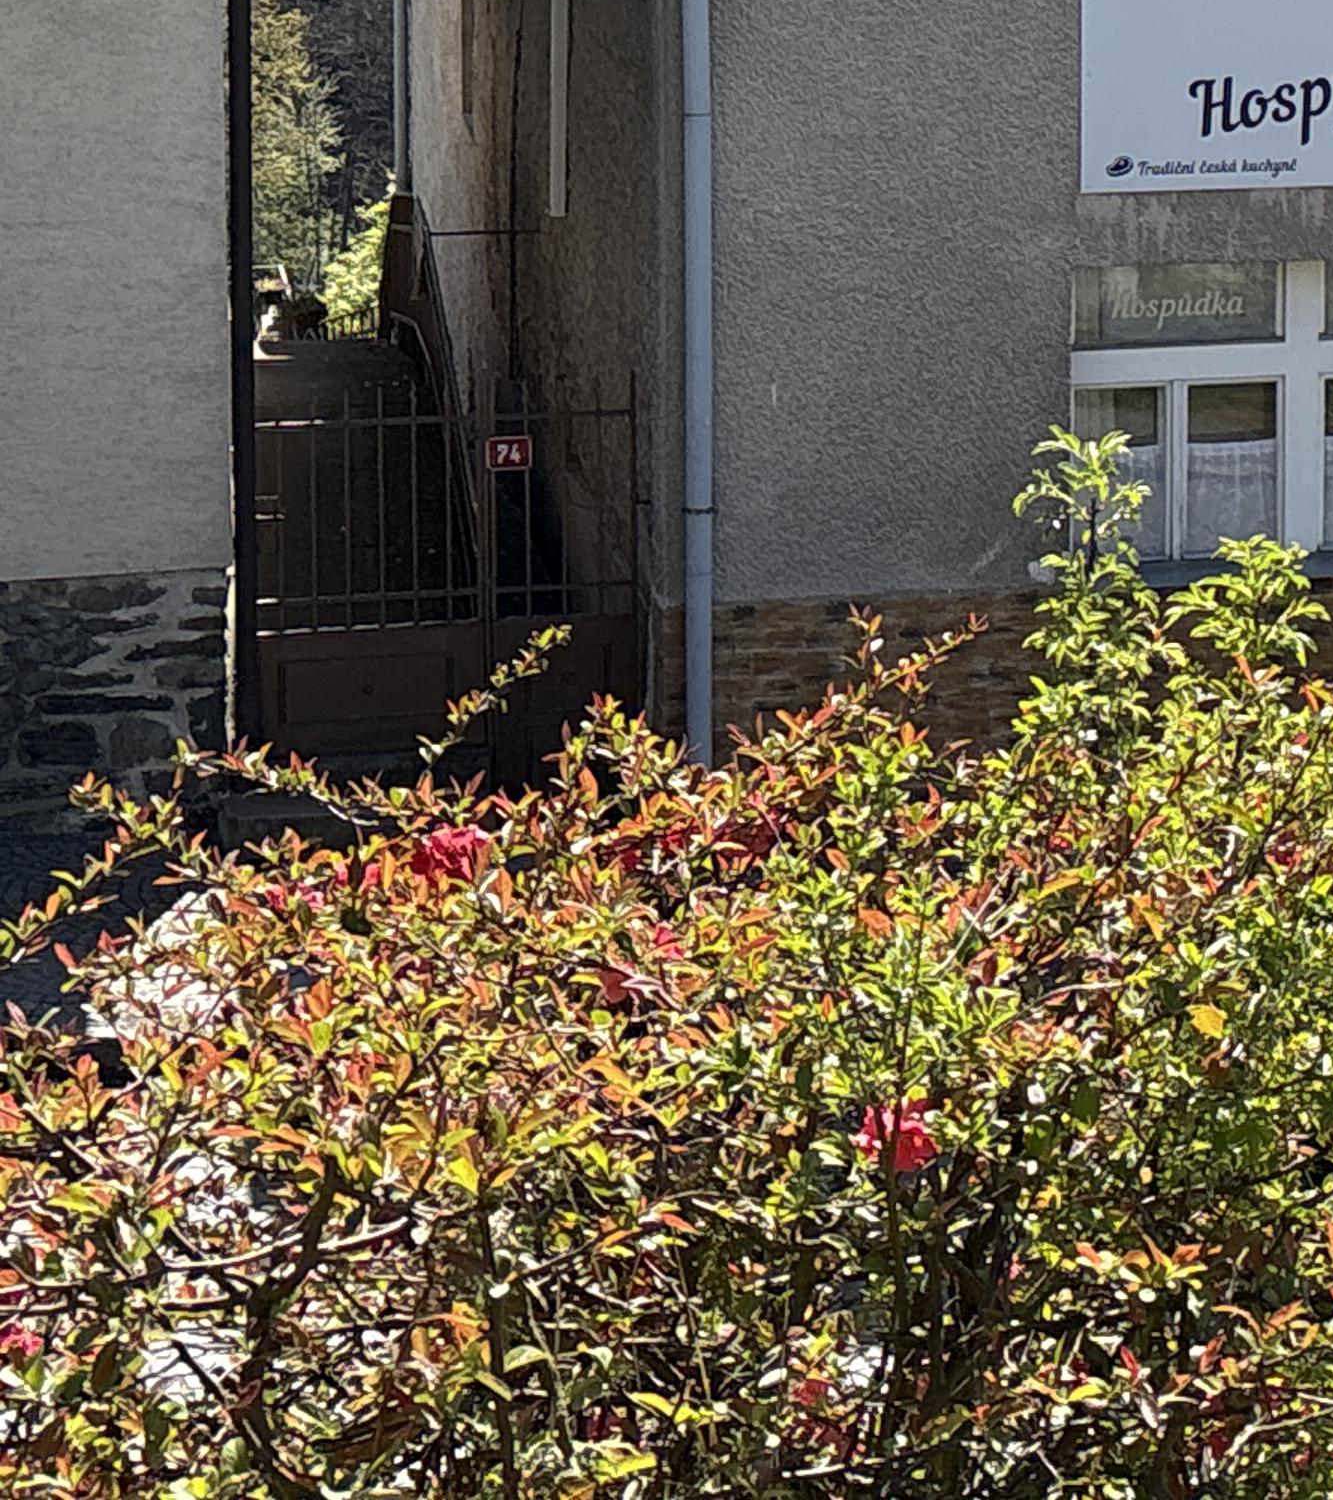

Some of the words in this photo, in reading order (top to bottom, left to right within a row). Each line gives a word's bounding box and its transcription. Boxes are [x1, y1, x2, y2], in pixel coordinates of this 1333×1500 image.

[1137, 160, 1196, 176] Tradiční
[1199, 158, 1238, 174] česká
[1240, 156, 1298, 179] kuchyně
[496, 442, 522, 465] 74
